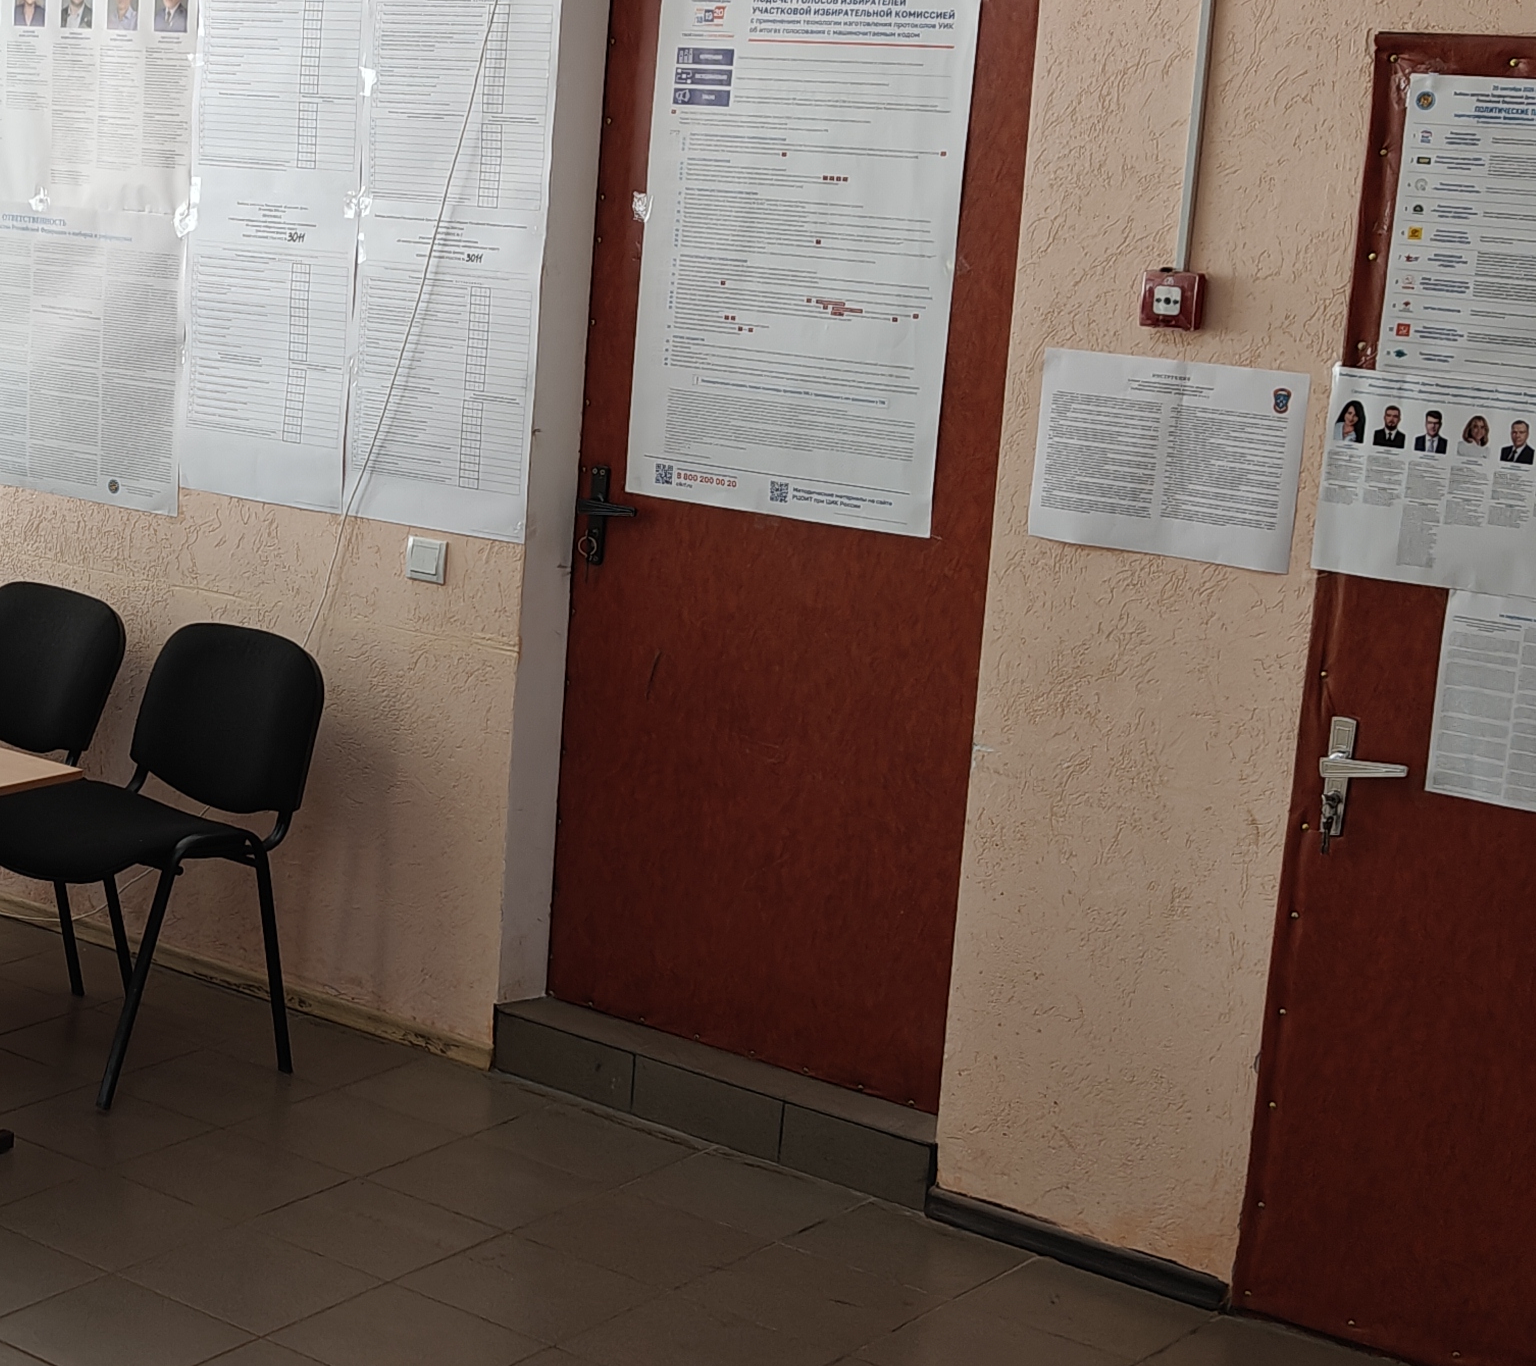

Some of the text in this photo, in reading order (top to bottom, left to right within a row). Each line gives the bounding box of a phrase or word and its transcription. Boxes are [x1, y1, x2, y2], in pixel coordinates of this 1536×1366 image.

[752, 6, 956, 20] УЧАСТКОВОЙ ИЗБИРАТЕЛЬНОЙ КОМИССИЕЙ
[465, 253, 484, 263] 3011
[699, 476, 714, 484] 200
[715, 478, 725, 486] 00
[727, 480, 737, 488] 20
